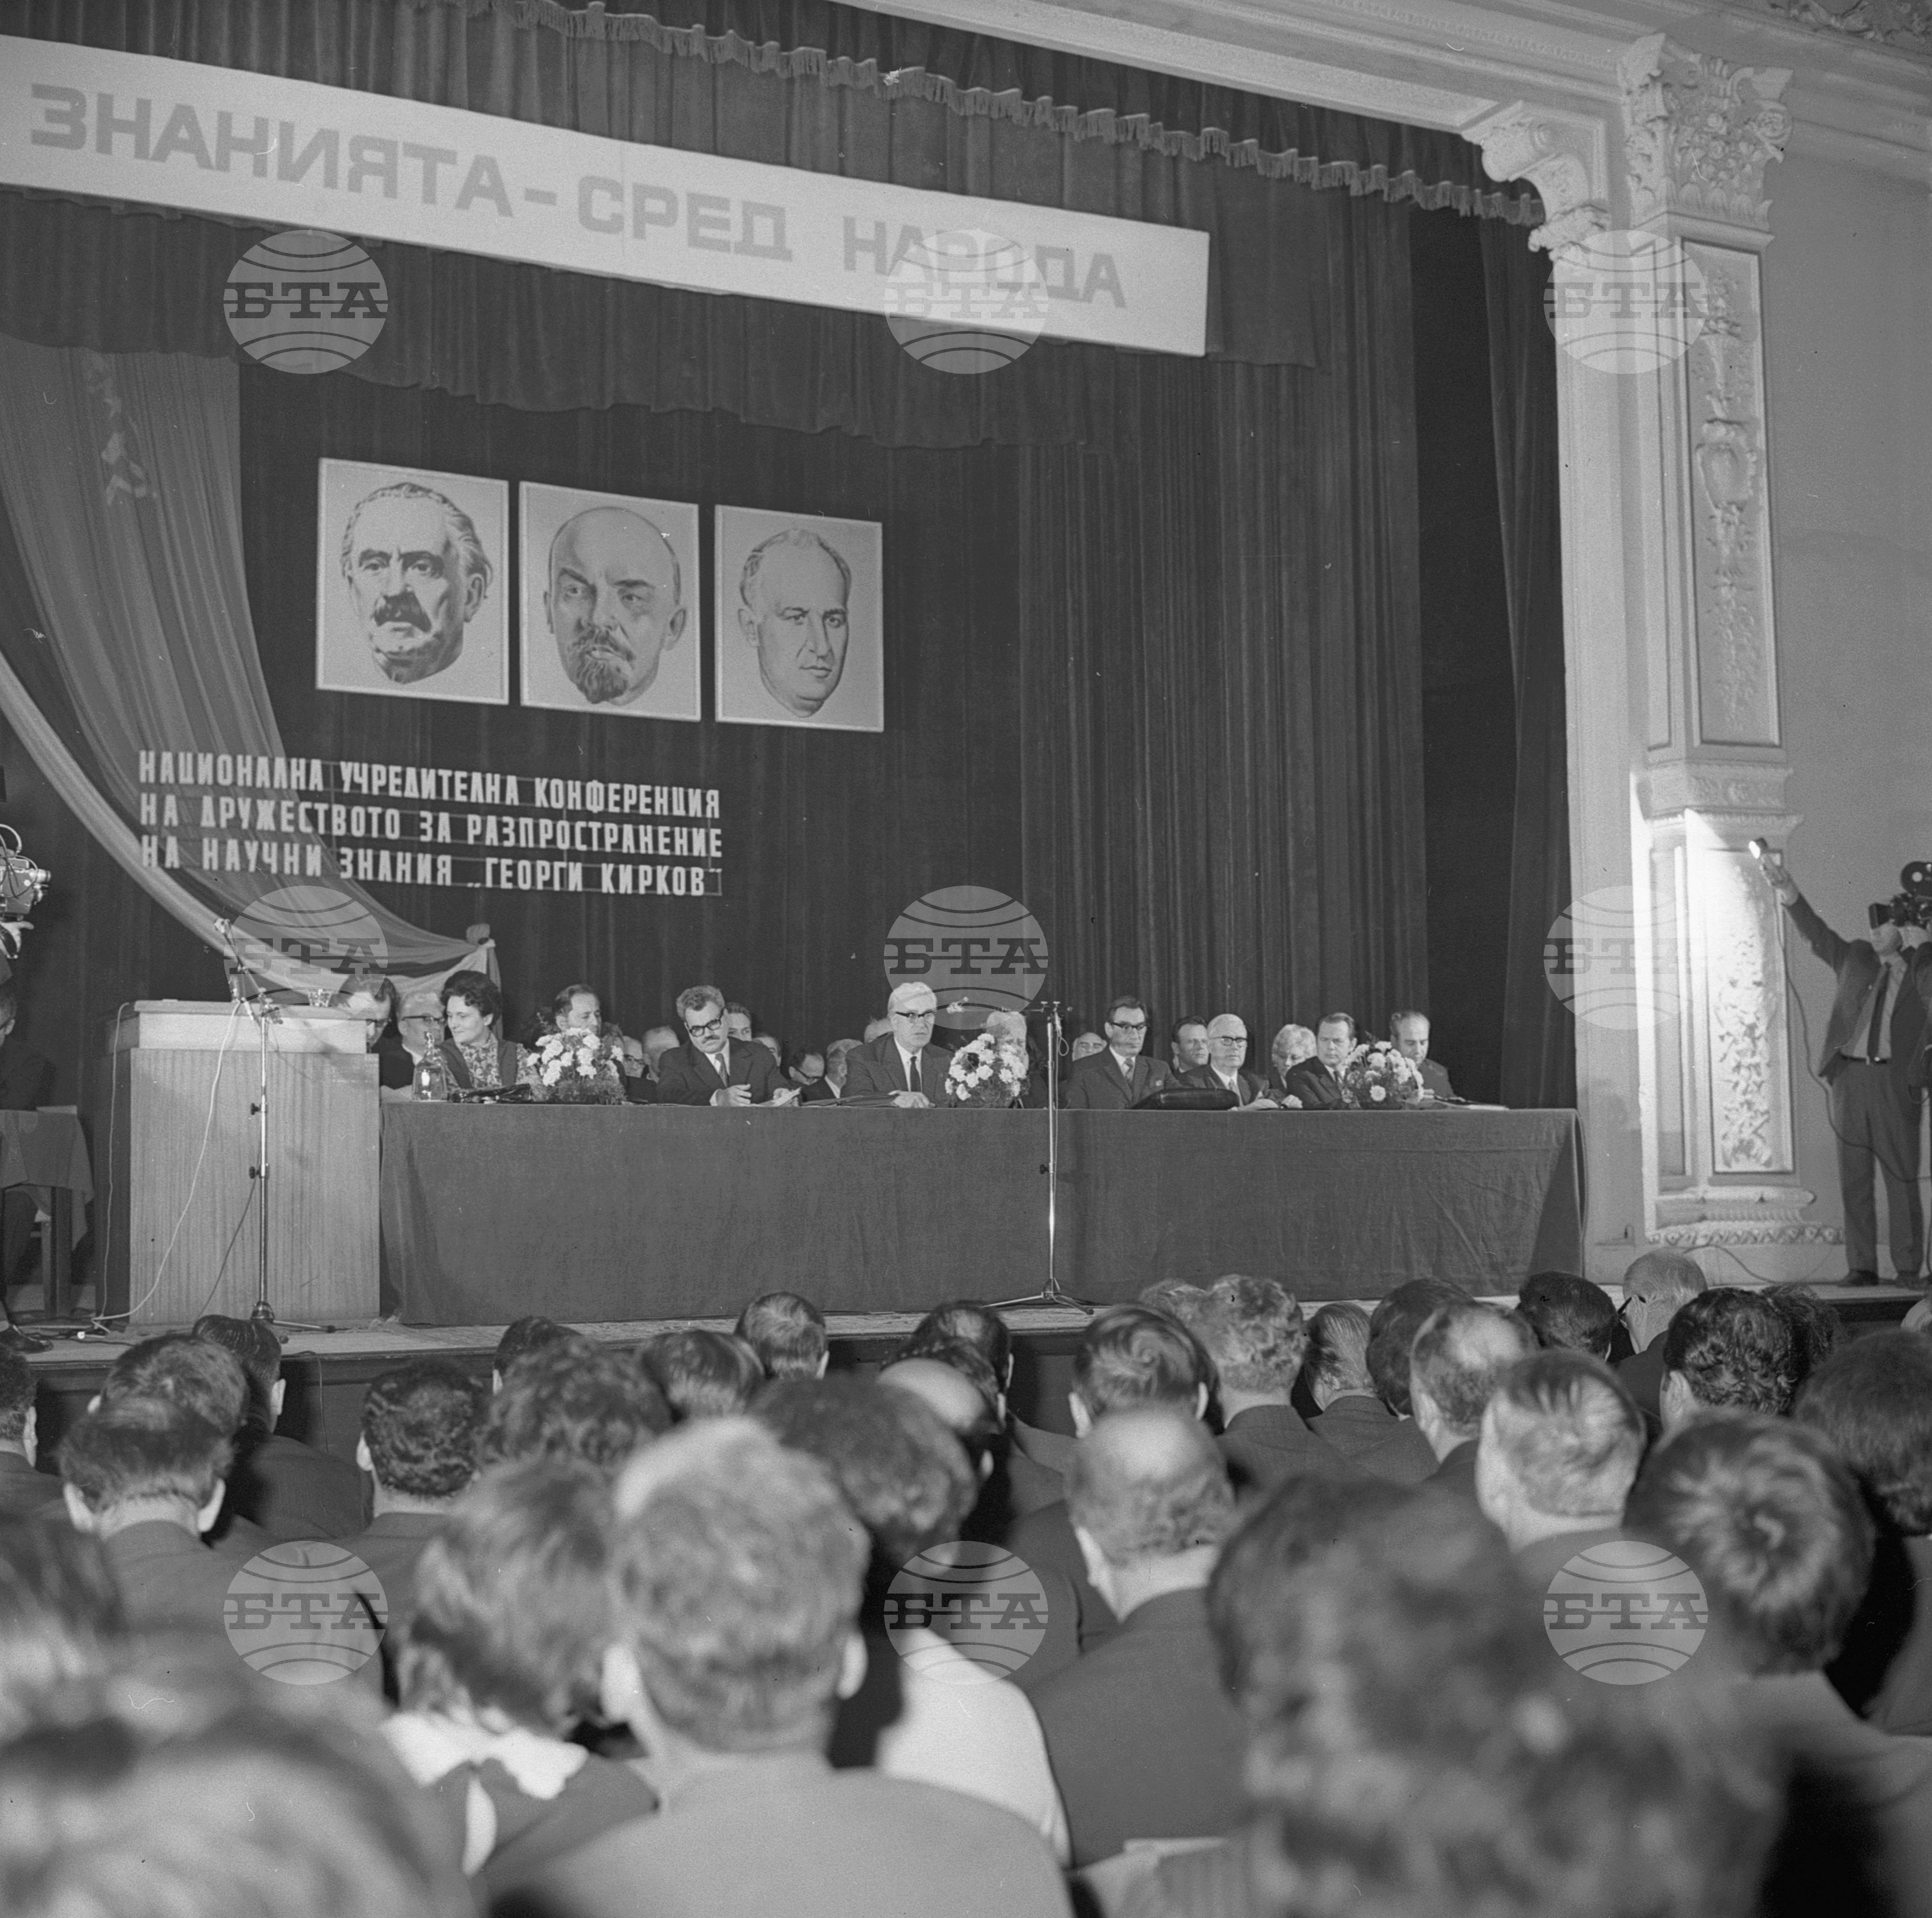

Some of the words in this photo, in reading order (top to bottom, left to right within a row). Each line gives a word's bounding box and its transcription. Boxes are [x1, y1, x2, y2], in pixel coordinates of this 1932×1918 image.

[30, 82, 513, 218] ЗНАНИЯТА
[579, 174, 793, 261] СРЕД
[842, 215, 1127, 309] НАРОДА
[139, 750, 324, 791] НАЦИОНАЛНА
[340, 761, 520, 806] УЧРЕДИТЕЛНА
[535, 777, 720, 818] КОНФЕРЕНЦИЯ
[140, 793, 179, 827] НА
[200, 795, 400, 840] ДРУЖЕСТВОТО
[420, 810, 451, 843] ЗА
[467, 814, 722, 858] РАЗПРОСТРАНЕНИЕ
[142, 835, 179, 869] НА
[202, 837, 322, 876] НАУЧНИ
[340, 847, 452, 886] ЗНАНИЯ
